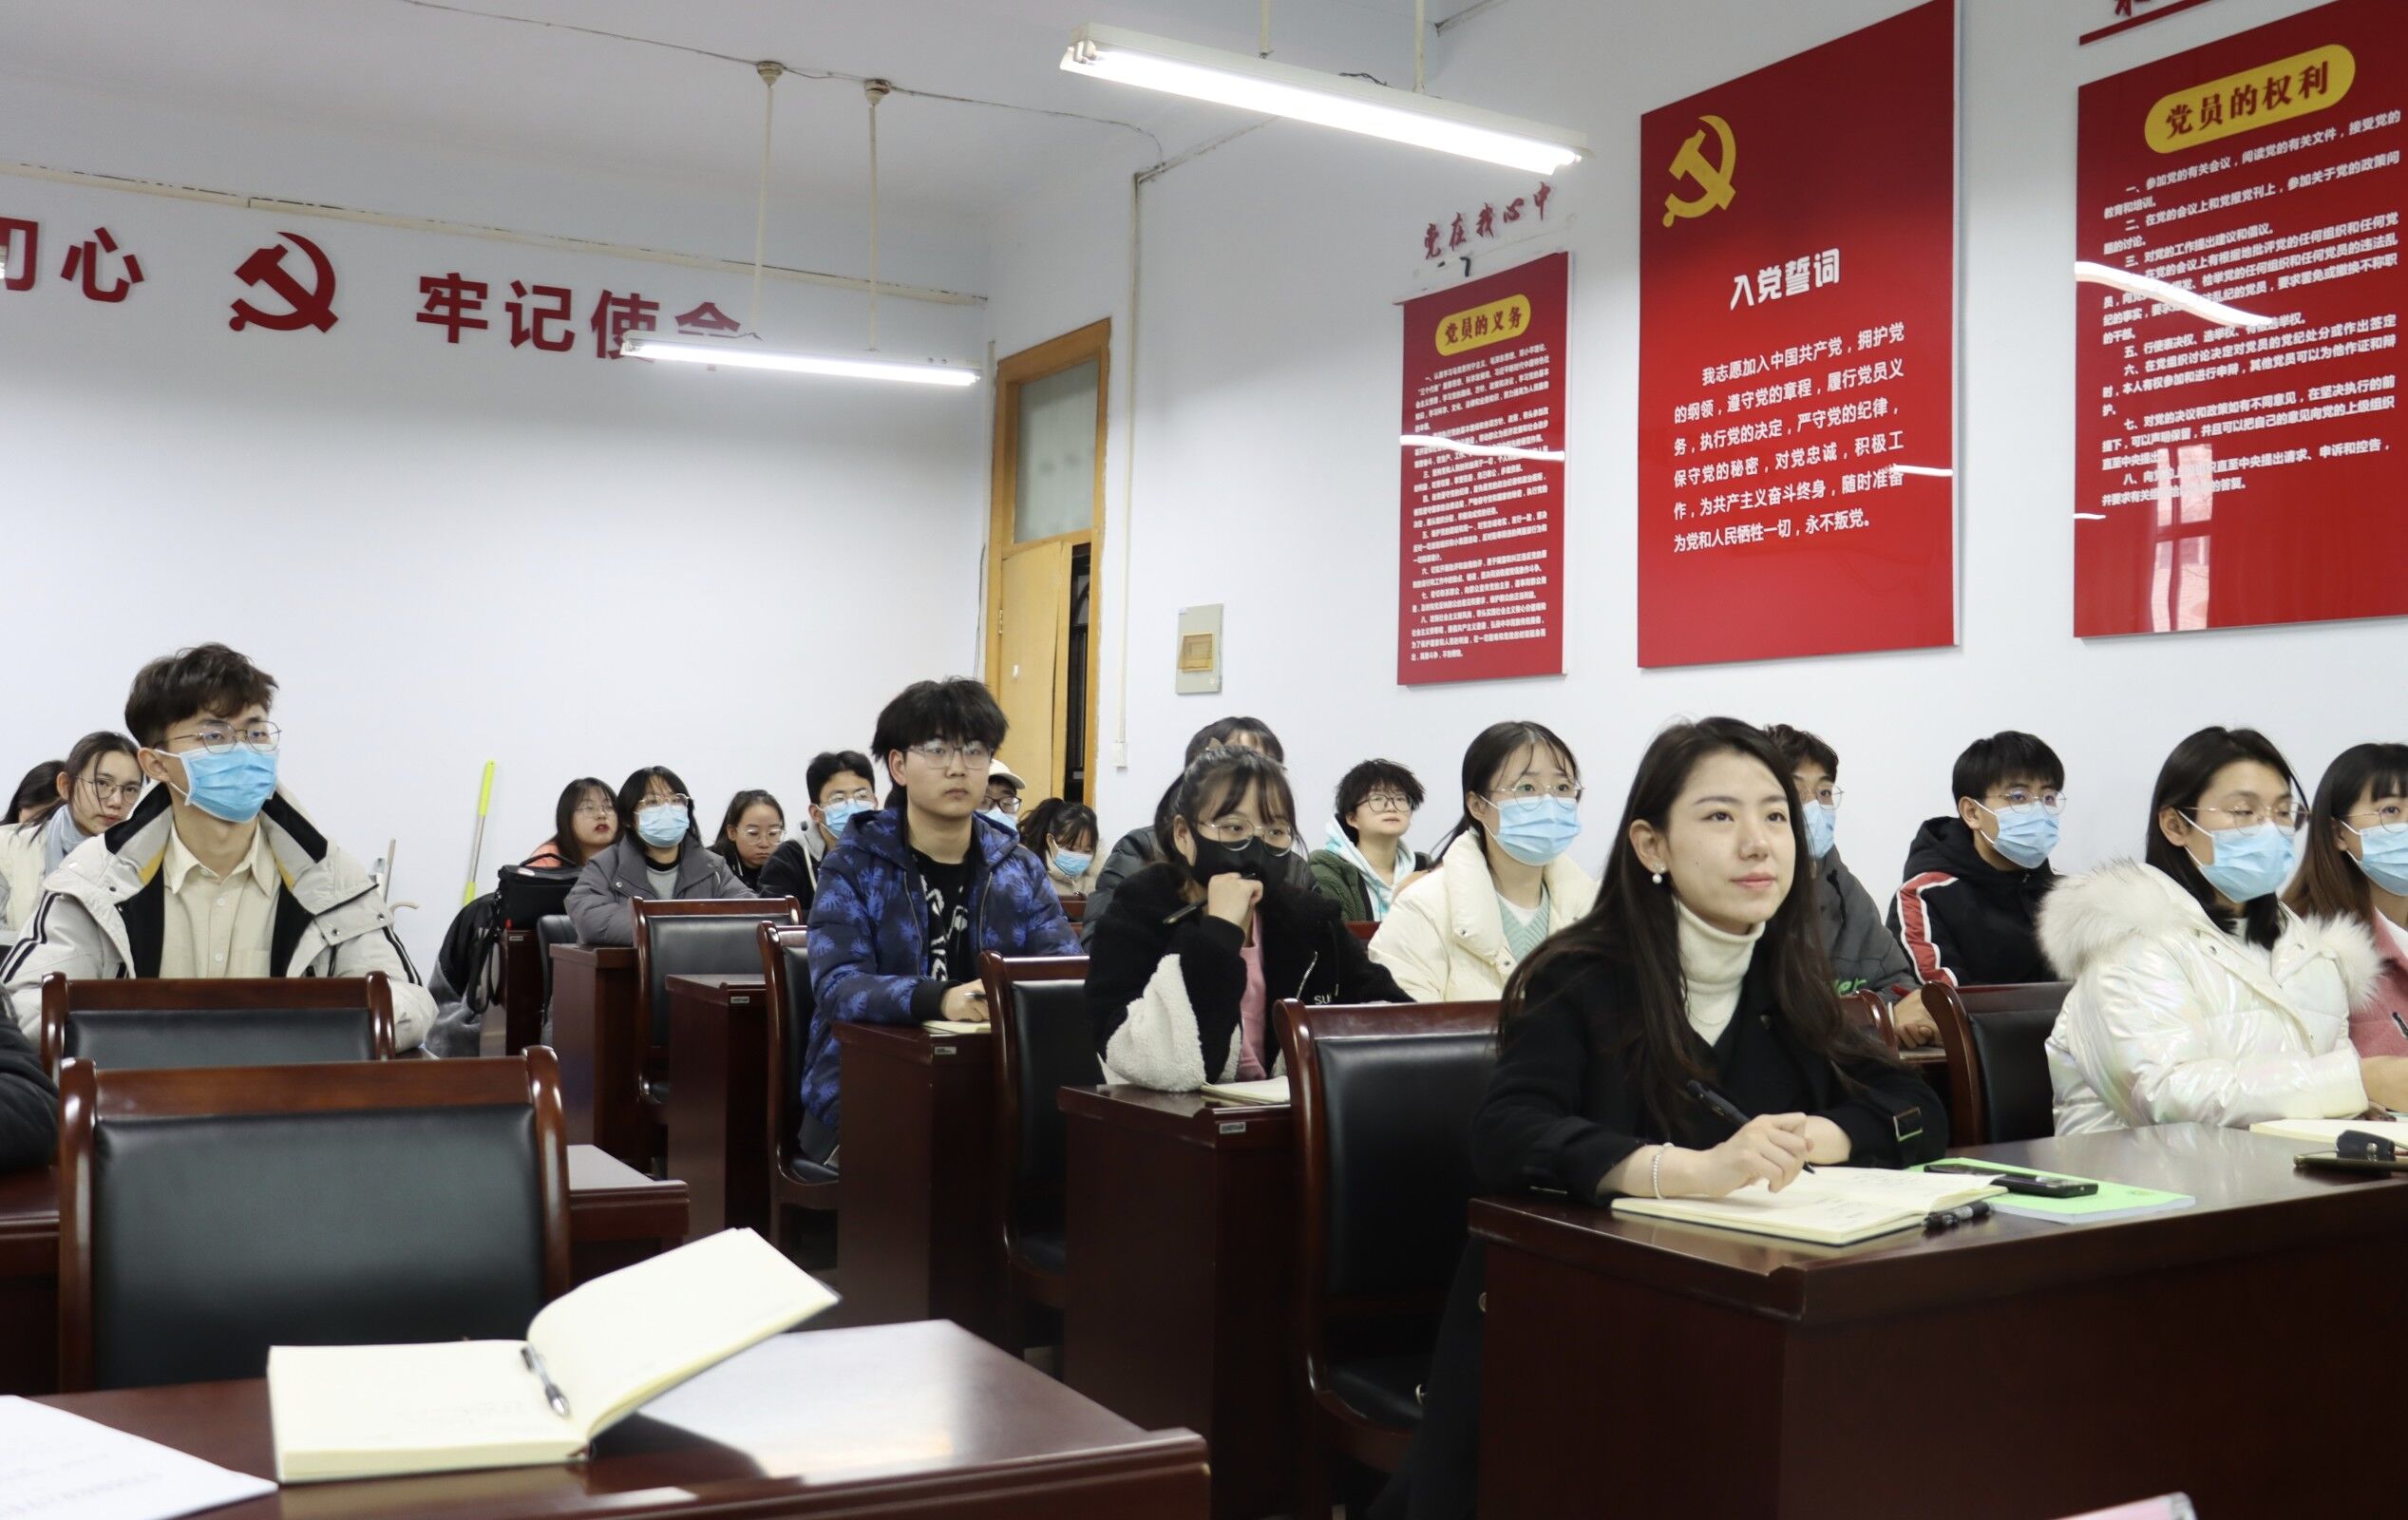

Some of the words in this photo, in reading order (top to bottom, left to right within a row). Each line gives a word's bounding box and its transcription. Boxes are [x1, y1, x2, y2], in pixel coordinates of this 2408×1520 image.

[2165, 60, 2328, 139] 党员的权利
[2124, 107, 2401, 197] 一、参加党的有关会议，阅读党的有关文件，接受党的
[2124, 148, 2399, 233] 二、在党的会议上和党报党刊上，参加关于党的政策问
[2124, 220, 2272, 268] 三、对党的工作提出建议和倡议。
[1730, 248, 1839, 310] 入党誓词
[1445, 306, 1522, 345] 党员的义务
[1702, 321, 1904, 386] 我志愿加入中国共产党，拥护党
[1674, 358, 1904, 424] 的纲领，遵守党的章程，履行党员义
[1674, 396, 1897, 456] 务，执行党的决定，严守党的纪律，
[1674, 430, 1904, 487] 保守党的秘密，对党忠诚，积极工
[1674, 463, 1904, 520] 作，为共产主义奋斗终身，随时准备
[1674, 507, 1868, 552] 为党和人民牺牲一切，永不叛党。
